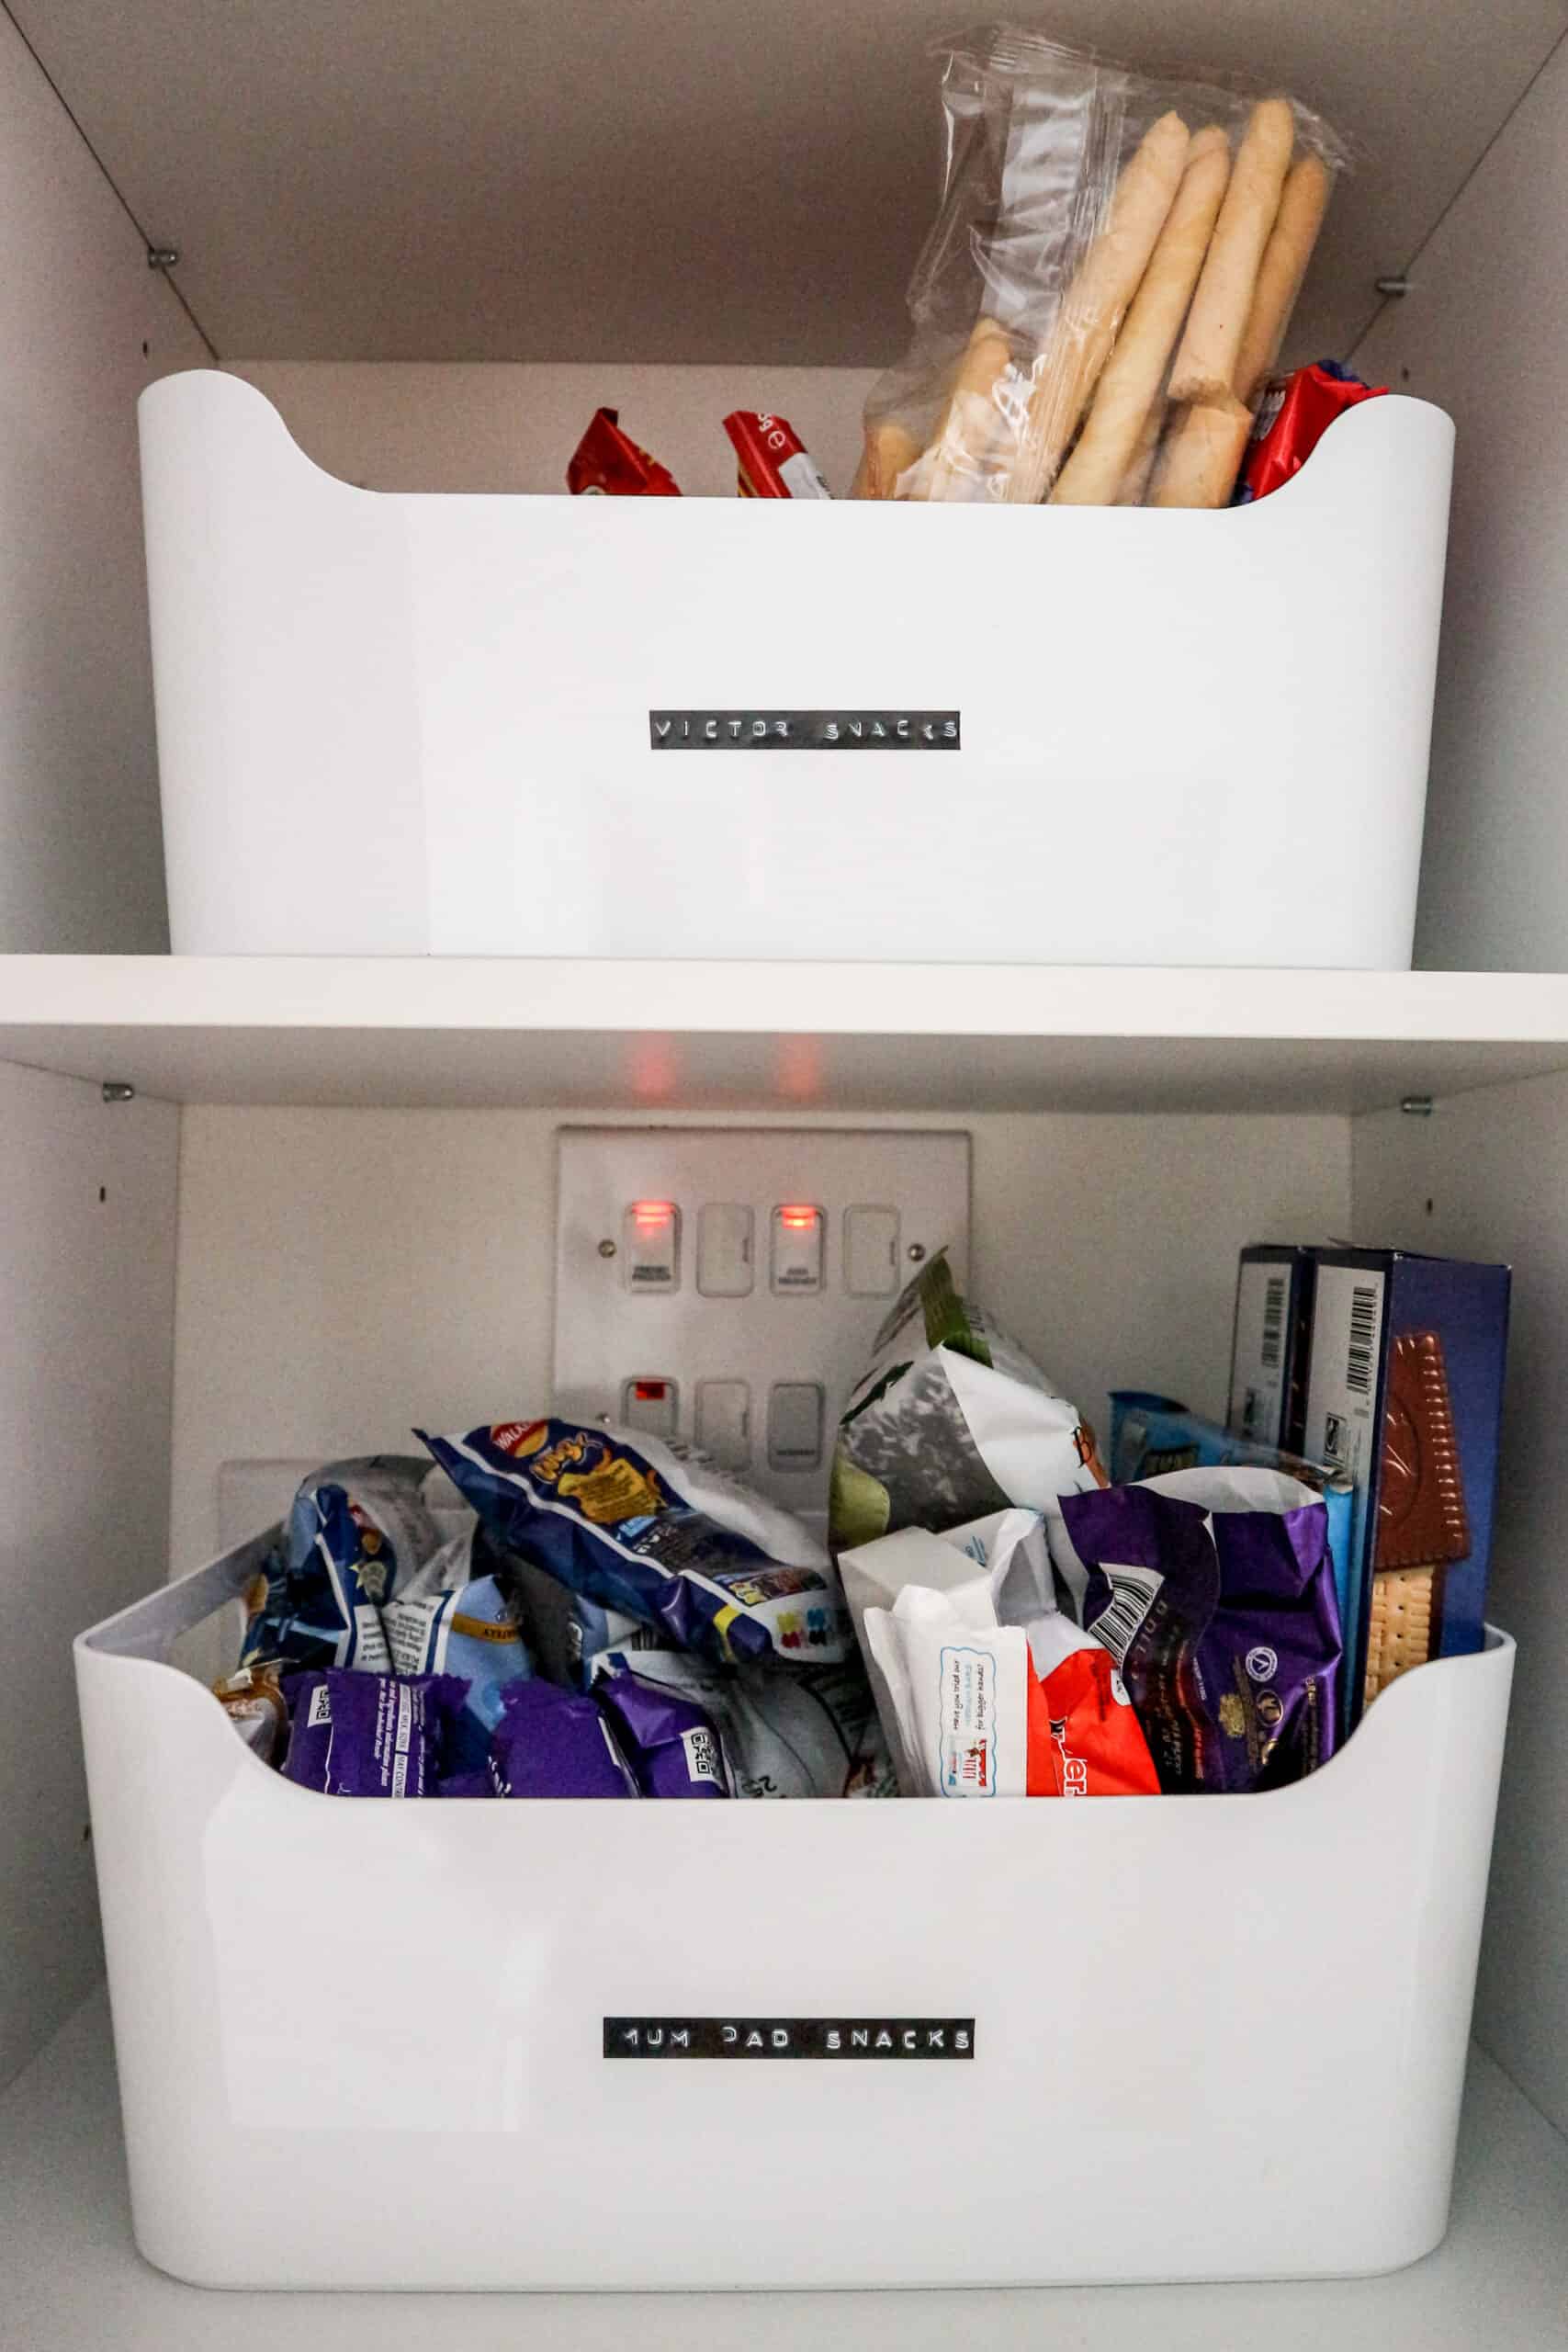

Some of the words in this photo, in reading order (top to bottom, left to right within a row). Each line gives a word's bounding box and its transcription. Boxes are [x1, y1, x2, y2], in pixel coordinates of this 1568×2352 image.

[655, 720, 788, 739] VICTOR
[823, 719, 958, 741] SNACKS
[827, 2027, 970, 2050] SNACKS
